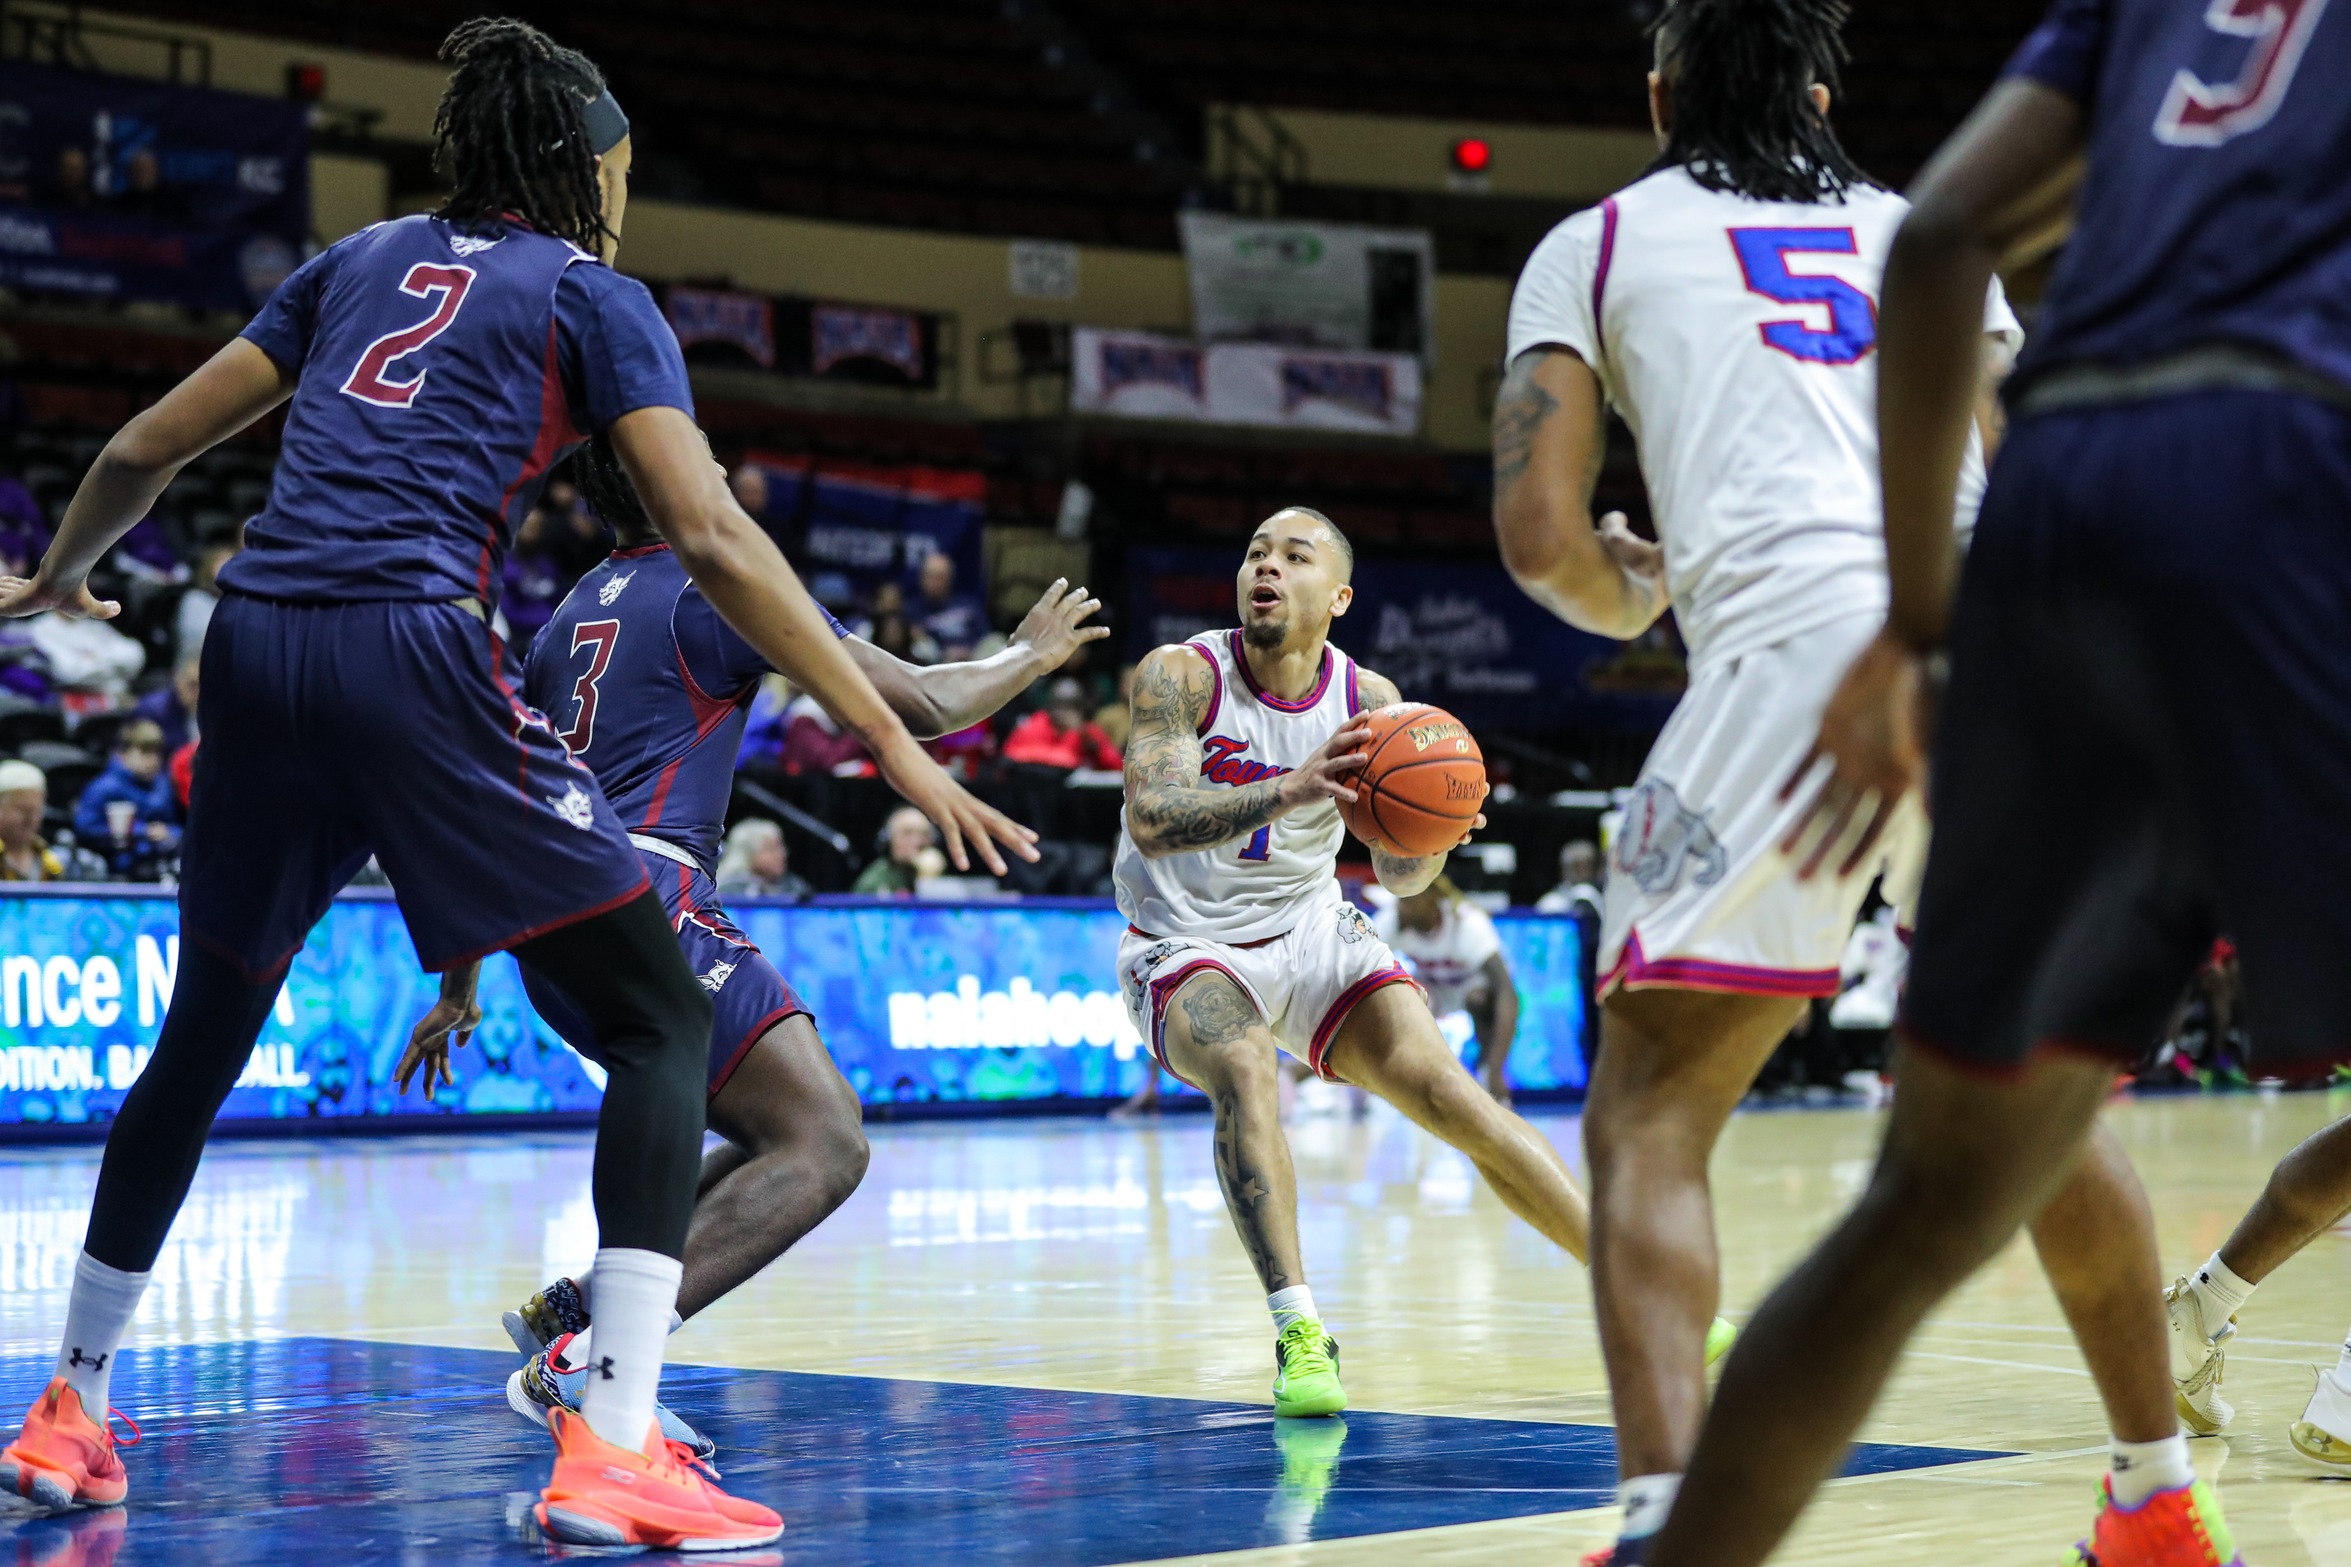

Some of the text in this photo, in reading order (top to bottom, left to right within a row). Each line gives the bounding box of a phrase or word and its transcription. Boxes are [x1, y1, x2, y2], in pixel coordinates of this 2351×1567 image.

[339, 261, 478, 409] 2
[1725, 226, 1878, 366] 5
[555, 618, 621, 756] 3
